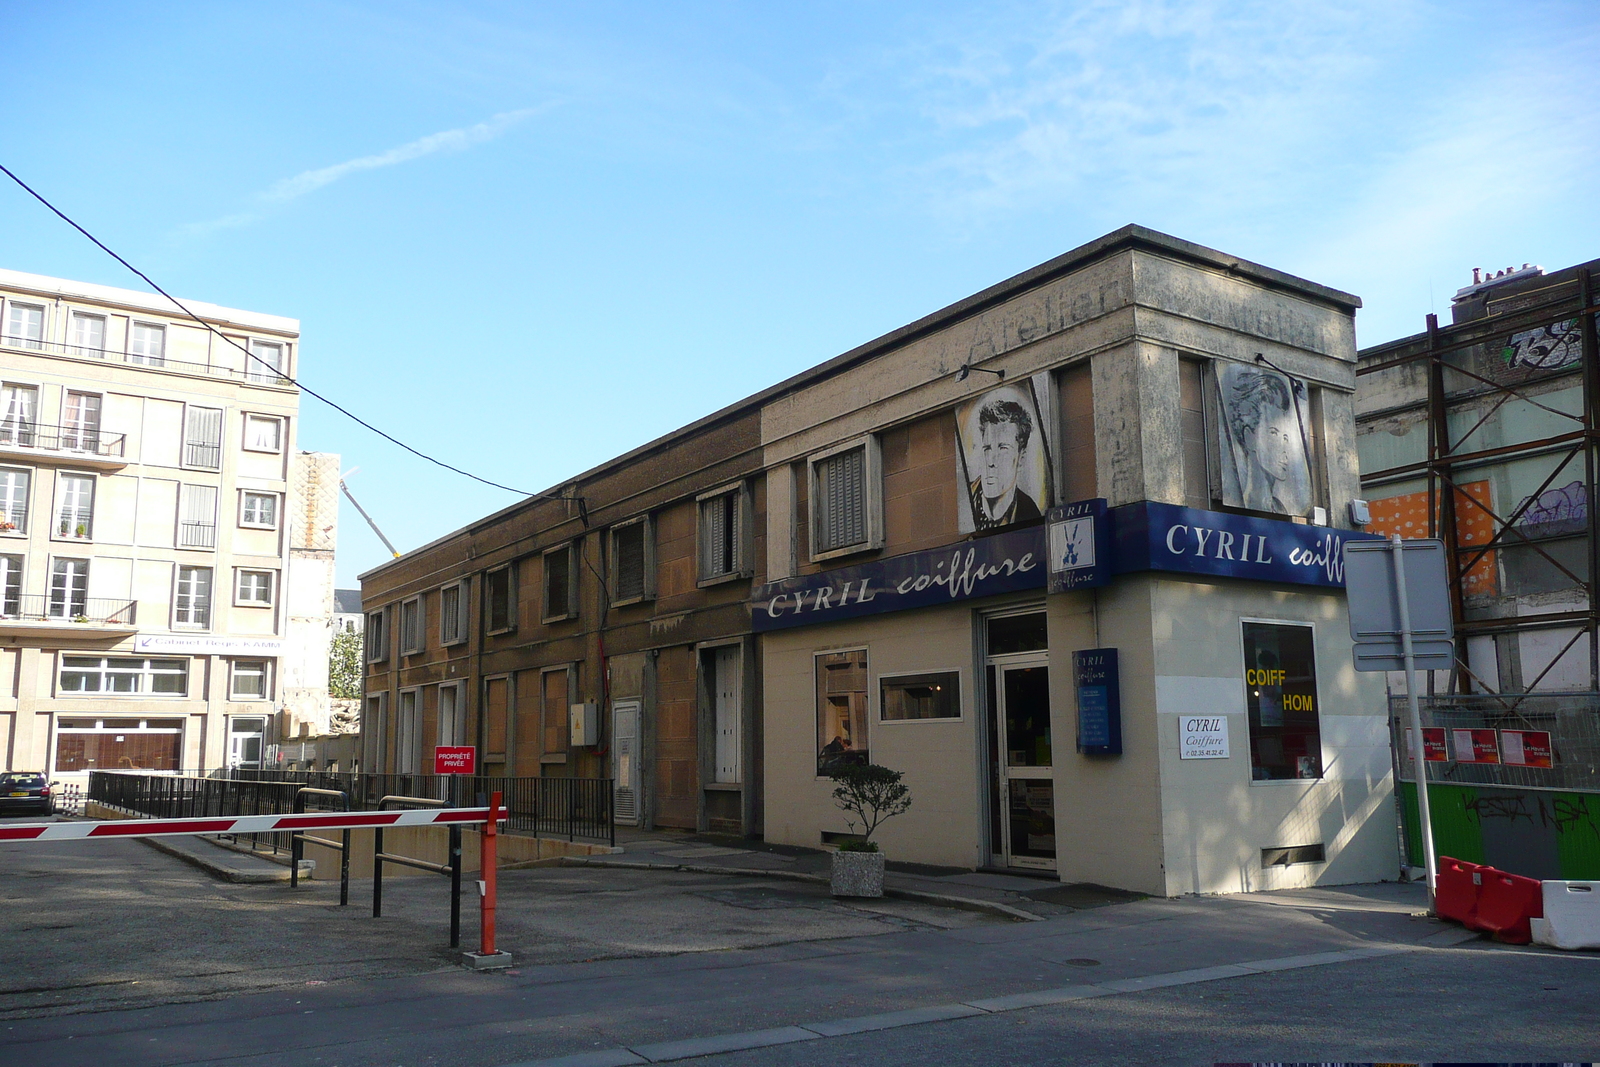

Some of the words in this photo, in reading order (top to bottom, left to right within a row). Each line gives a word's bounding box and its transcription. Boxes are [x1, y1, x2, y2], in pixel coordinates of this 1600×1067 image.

[1050, 503, 1093, 521] CYRIL
[1166, 524, 1272, 564] CYRIL
[1289, 533, 1345, 583] coiff
[767, 578, 876, 618] CYRIL
[897, 548, 1037, 598] coiffure
[1053, 570, 1094, 588] coiffure
[155, 638, 200, 646] Cabinet
[1076, 655, 1104, 666] CYRIL
[1246, 668, 1286, 686] COIFF
[1283, 694, 1313, 711] HOM
[1186, 718, 1221, 733] CYRIL
[1185, 735, 1224, 748] Coiffure
[438, 752, 470, 760] PROPRIÉTÉ
